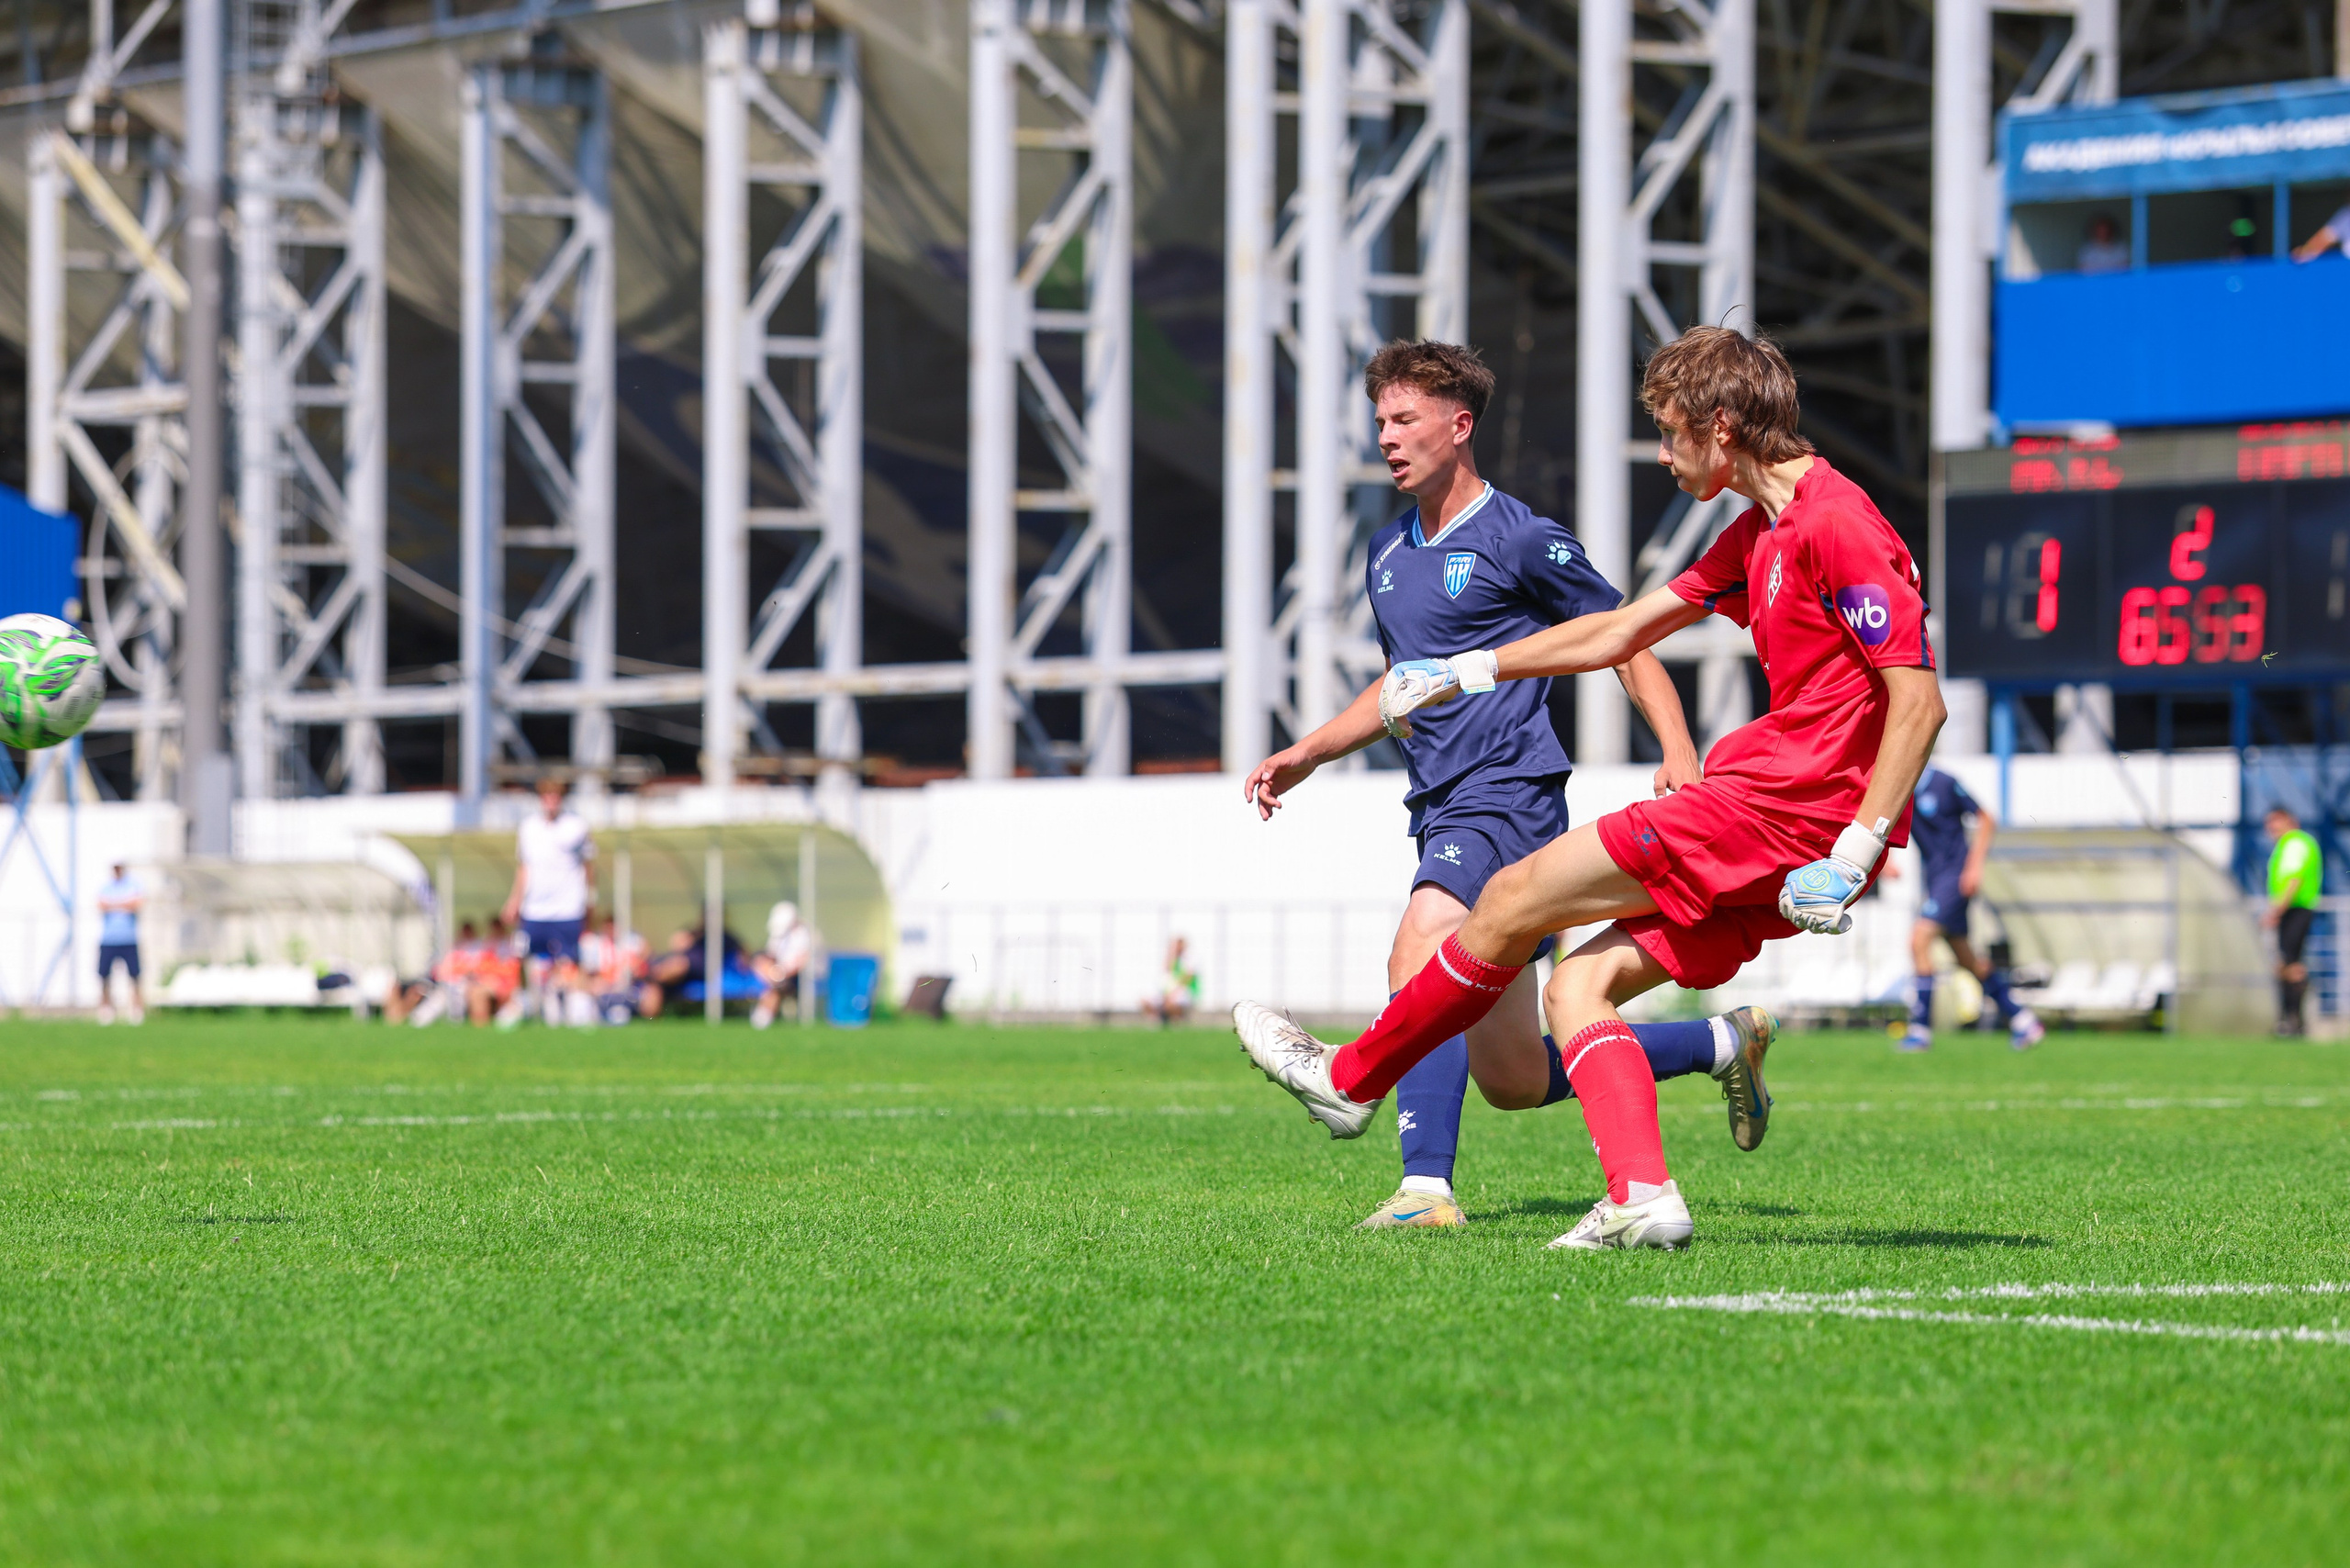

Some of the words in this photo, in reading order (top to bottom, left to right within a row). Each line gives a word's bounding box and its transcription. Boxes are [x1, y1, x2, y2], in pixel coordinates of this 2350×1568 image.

[2169, 505, 2215, 581] 2
[1449, 556, 1472, 565] PARI
[1378, 585, 1394, 594] KELME
[1842, 597, 1887, 629] wb
[1433, 853, 1461, 866] KELME
